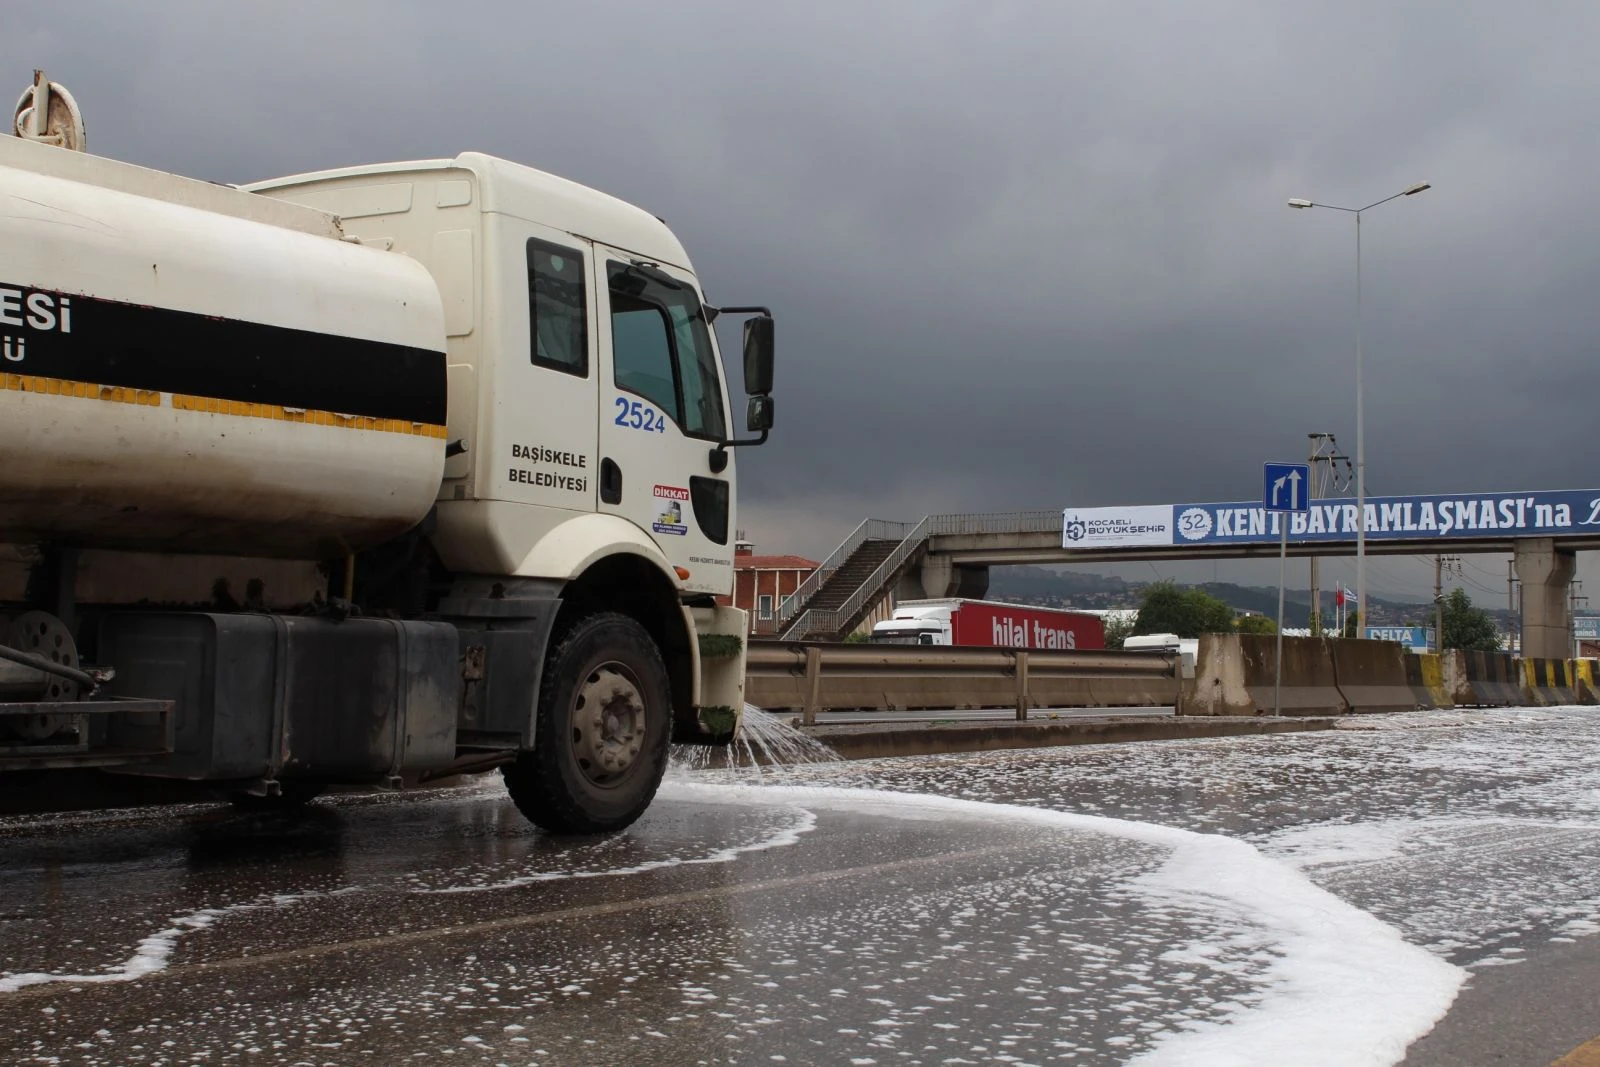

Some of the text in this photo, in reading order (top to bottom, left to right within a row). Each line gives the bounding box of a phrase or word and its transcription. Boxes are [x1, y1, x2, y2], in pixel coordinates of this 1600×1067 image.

[614, 397, 665, 433] 2524
[512, 444, 586, 468] BAŞİSKELE
[509, 468, 587, 492] BELEDİYESİ
[654, 487, 688, 500] DİKKAT
[1216, 508, 1283, 537] KENT
[992, 616, 1075, 650] hilal trans
[1370, 629, 1413, 642] DELTA
